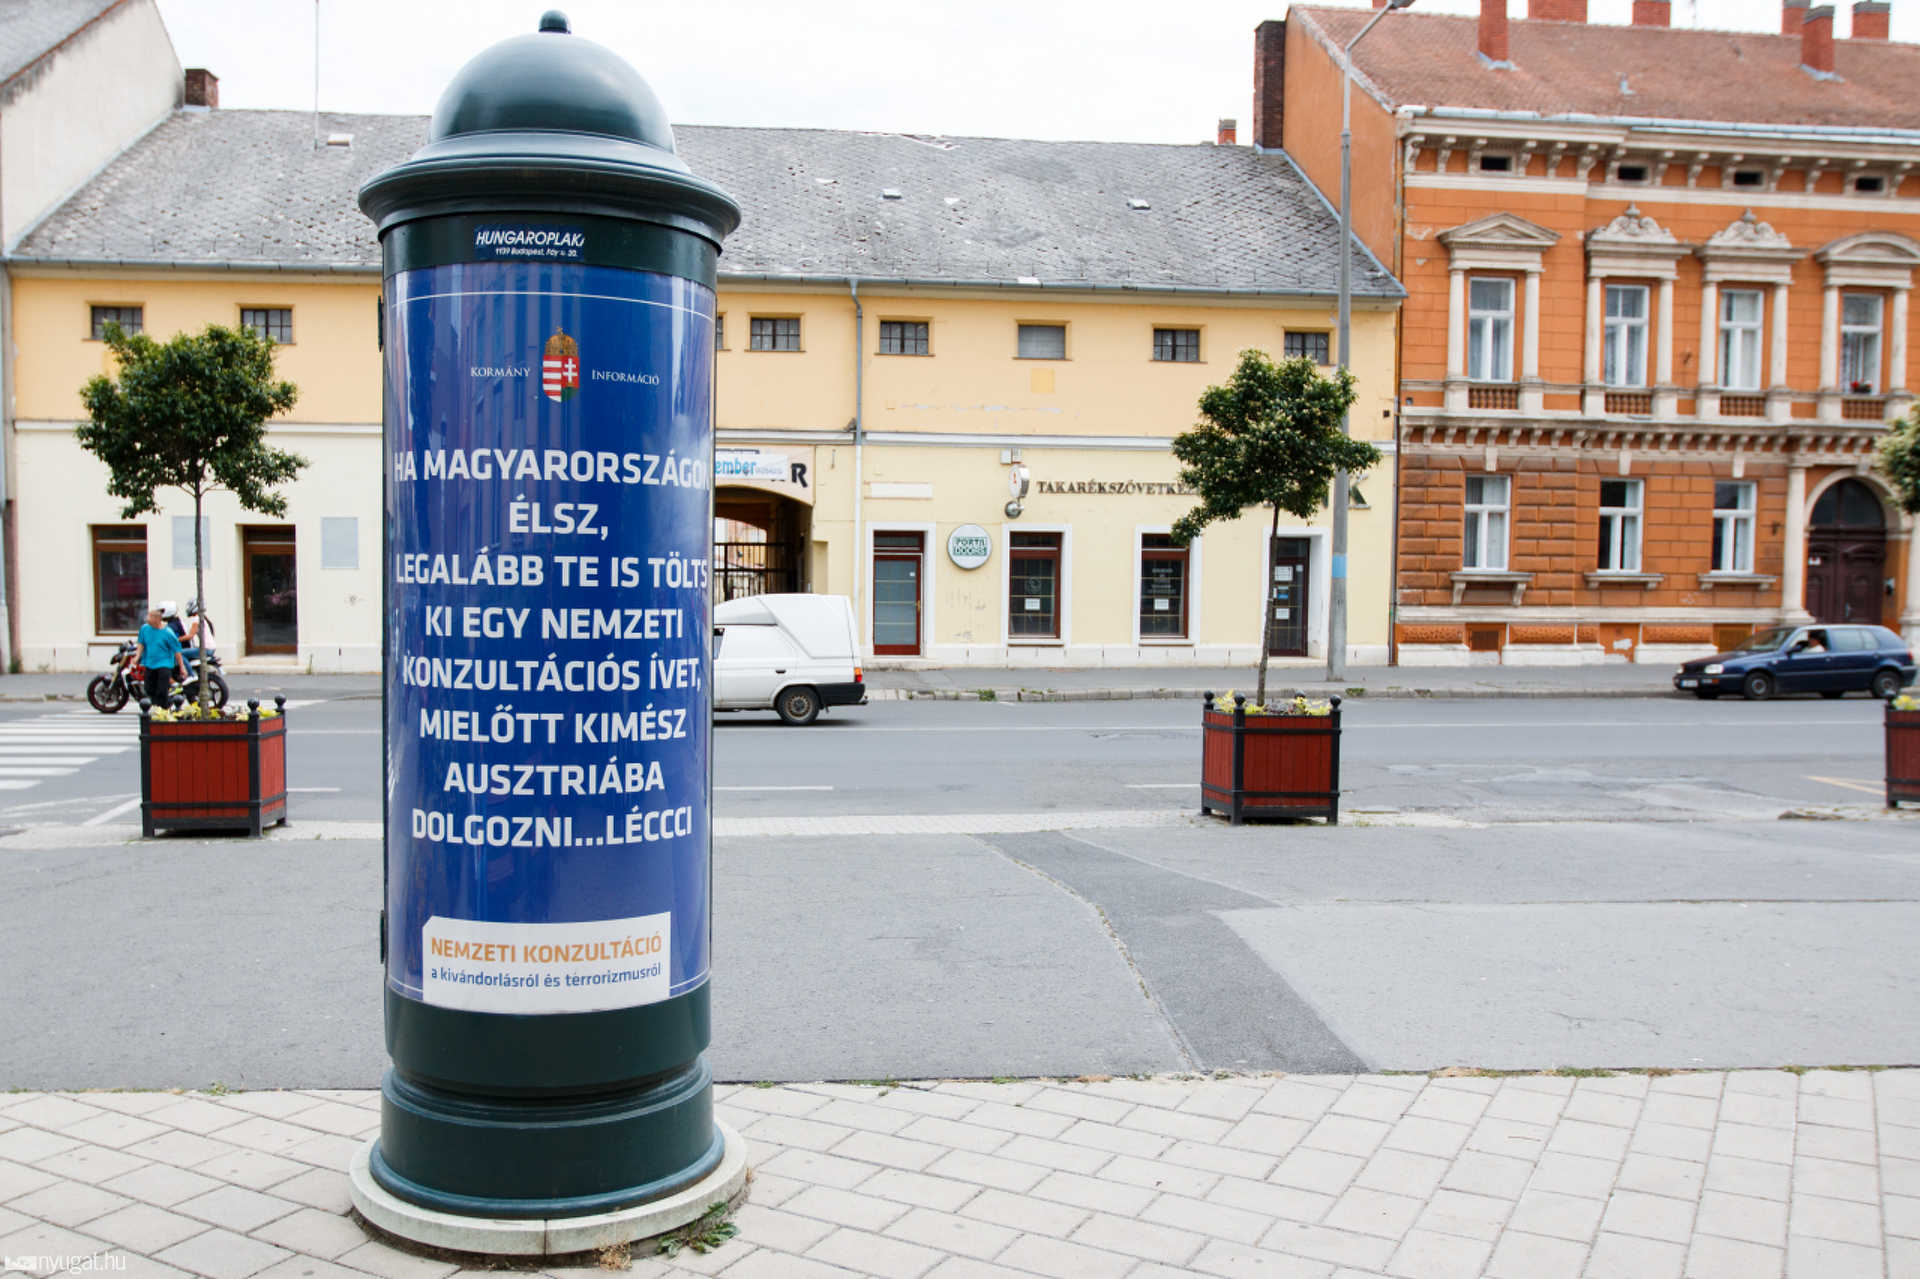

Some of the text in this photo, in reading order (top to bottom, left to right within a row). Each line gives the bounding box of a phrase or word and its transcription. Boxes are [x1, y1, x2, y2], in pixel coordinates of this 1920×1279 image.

[470, 365, 660, 385] KORMÁNY INFORMÁCIÓ
[394, 450, 417, 482] HA
[509, 493, 609, 541] ÉLSZ,
[396, 545, 708, 589] LEGALÁBB TE IS TÖLTS
[425, 606, 683, 639] KI EGY NEMZETI
[403, 652, 700, 692] KONZULTÁCIÓS ÍVET,
[420, 703, 686, 743] MIELŐTT KIMÉSZ
[443, 755, 665, 796] AUSZTRIÁBA
[431, 931, 662, 964] NEMZETI KONZULTÁCIÓ
[431, 963, 661, 988] a kivándorlásról és terrorizmusról
